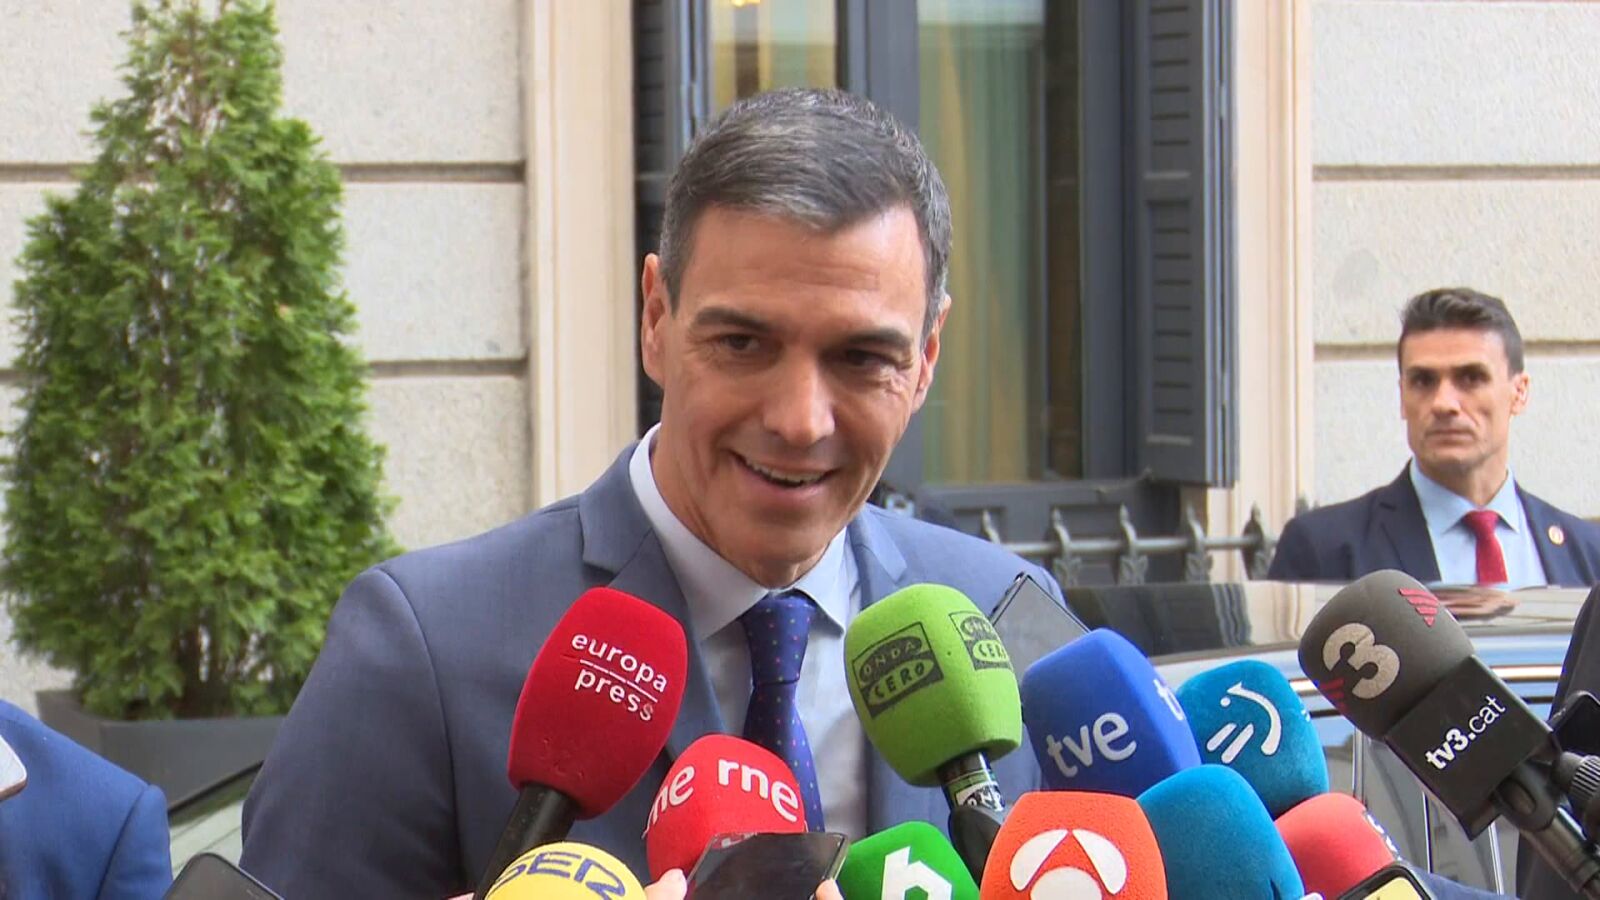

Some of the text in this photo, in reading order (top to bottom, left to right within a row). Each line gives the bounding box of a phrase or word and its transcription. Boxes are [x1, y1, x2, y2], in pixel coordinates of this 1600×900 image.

[571, 633, 668, 693] europa
[863, 641, 918, 676] ONDA
[873, 662, 926, 699] CERO
[1322, 622, 1400, 699] 3
[574, 667, 655, 722] press
[1047, 712, 1137, 779] tve
[1425, 694, 1506, 771] tv3.cat
[718, 758, 799, 823] rne
[487, 851, 626, 900] SER
